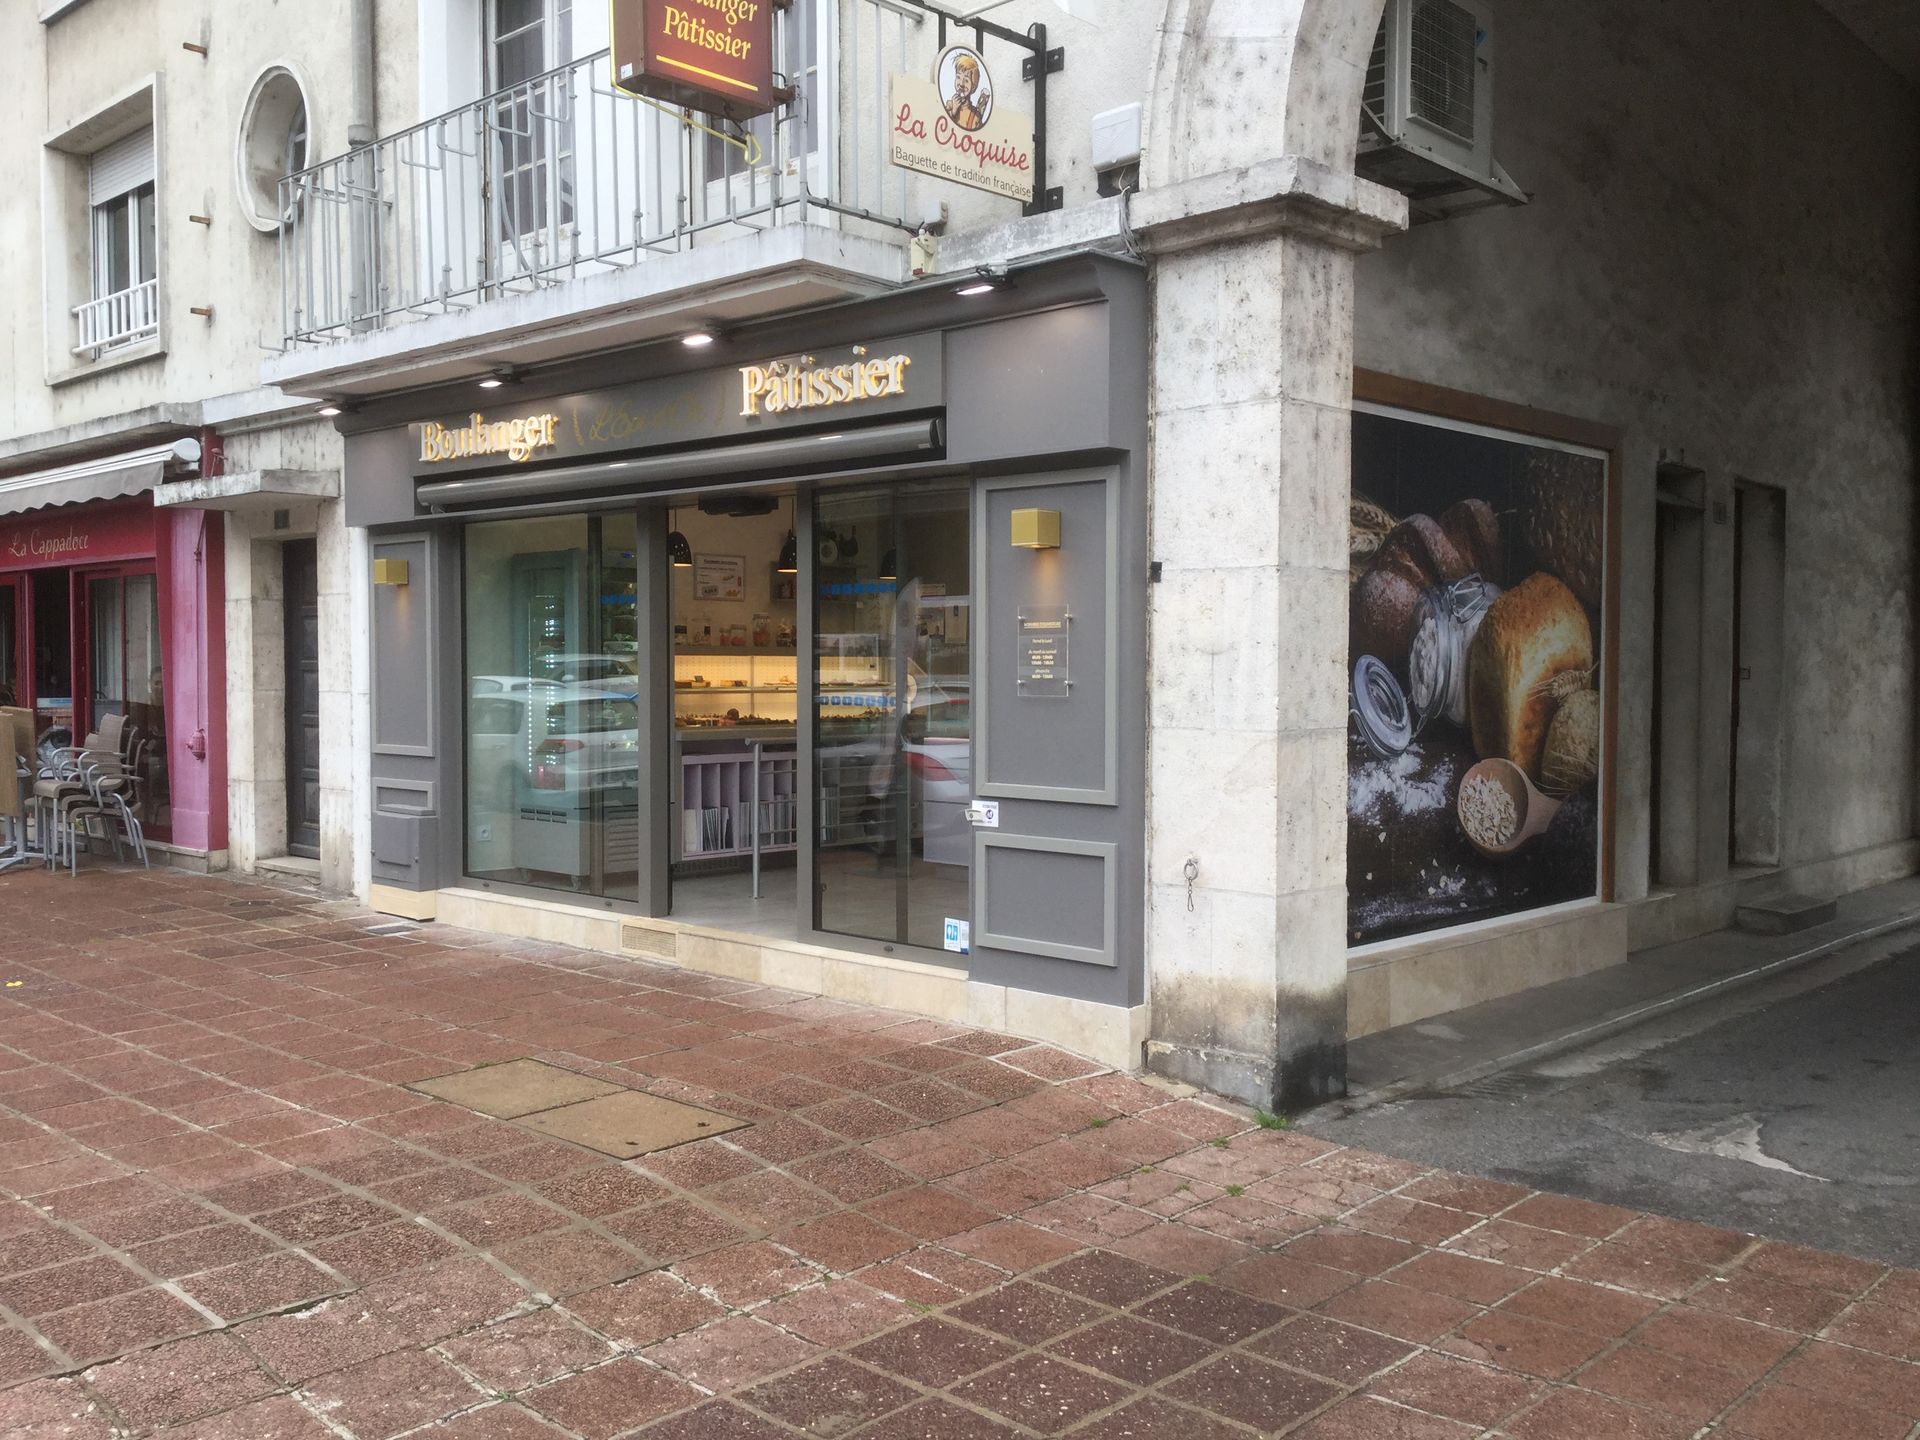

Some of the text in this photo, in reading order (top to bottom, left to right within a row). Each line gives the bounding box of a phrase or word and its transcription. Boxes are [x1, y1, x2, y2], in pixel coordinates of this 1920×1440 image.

[662, 5, 751, 60] Pâtissier
[894, 103, 1029, 170] La Croquise
[895, 146, 1032, 198] Baguette de tradition française
[739, 345, 911, 416] Pâtissier
[419, 412, 557, 462] Boulanger
[8, 532, 27, 557] La
